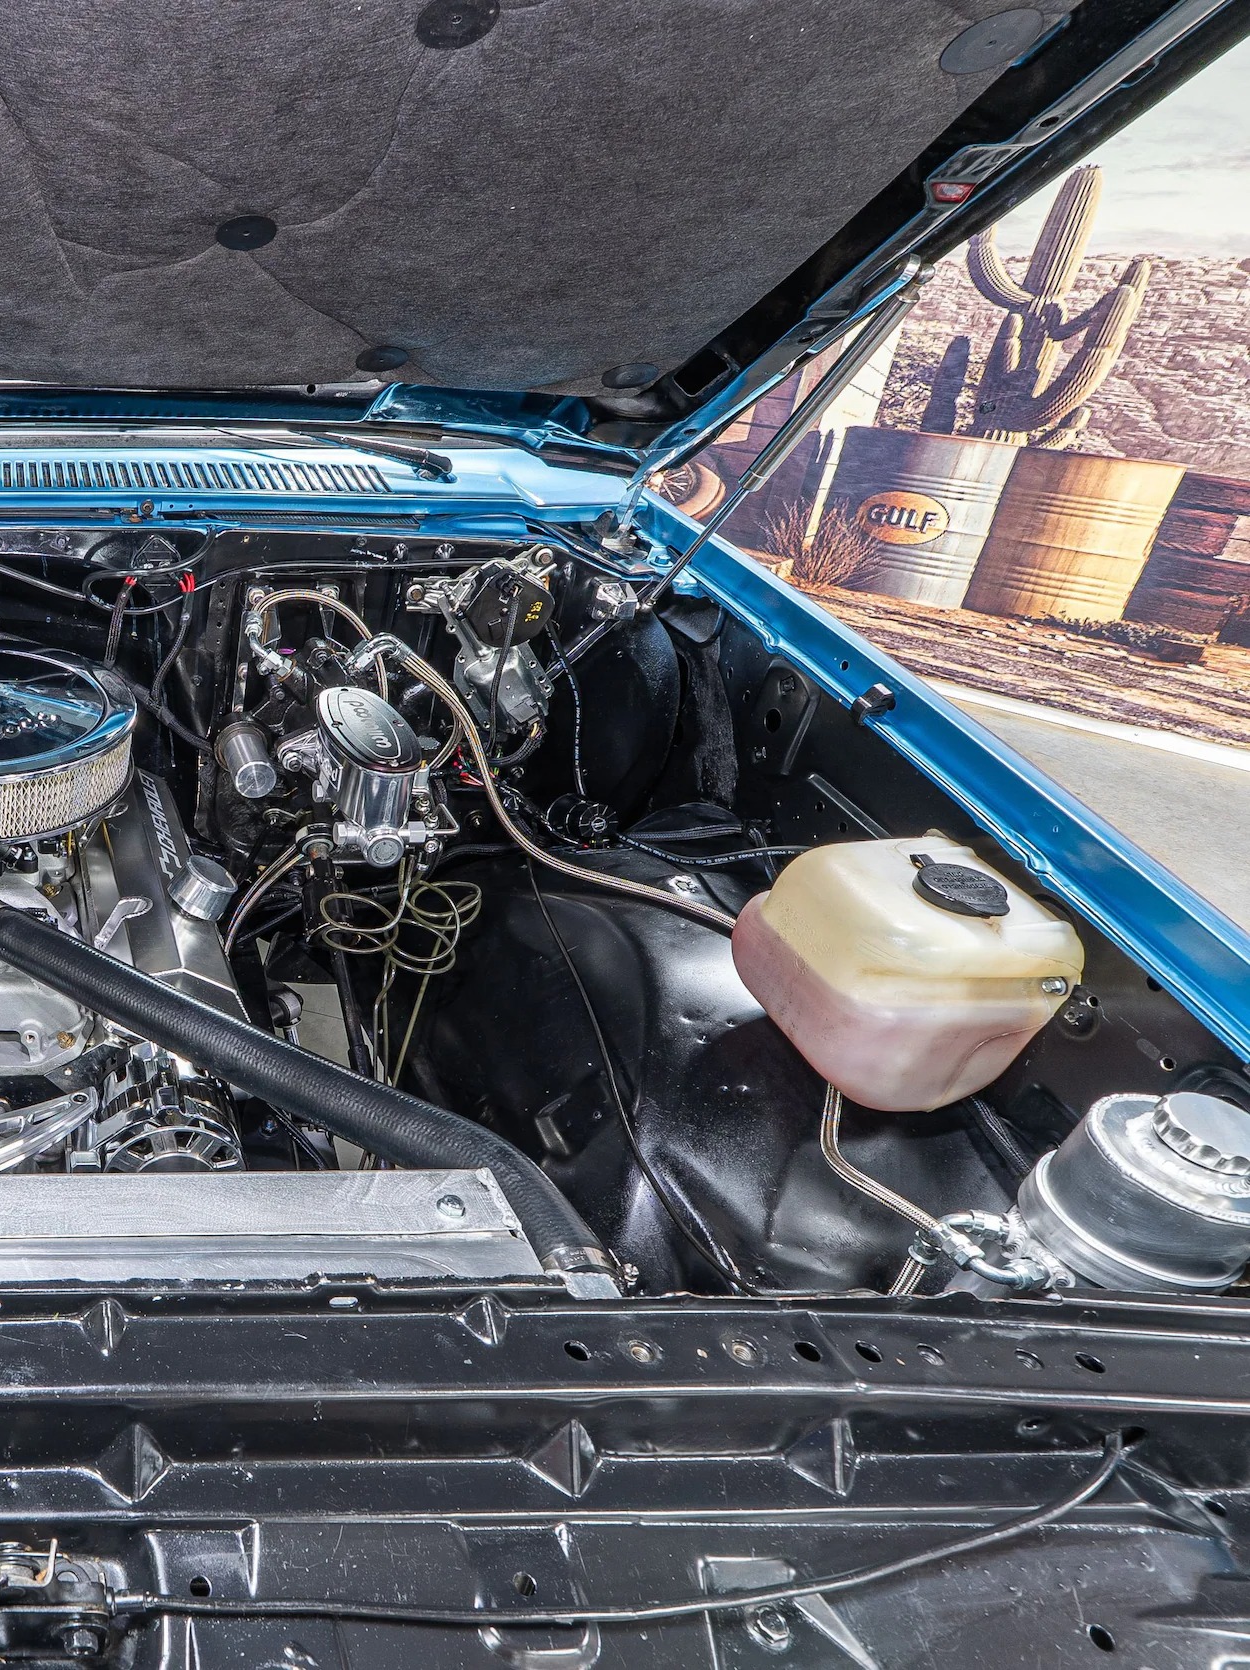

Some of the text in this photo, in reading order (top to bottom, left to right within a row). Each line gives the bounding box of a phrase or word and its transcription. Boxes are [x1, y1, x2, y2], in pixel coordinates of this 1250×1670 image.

[867, 503, 939, 534] GULF
[342, 700, 393, 748] wilwood
[137, 769, 177, 854] CHEVROLET
